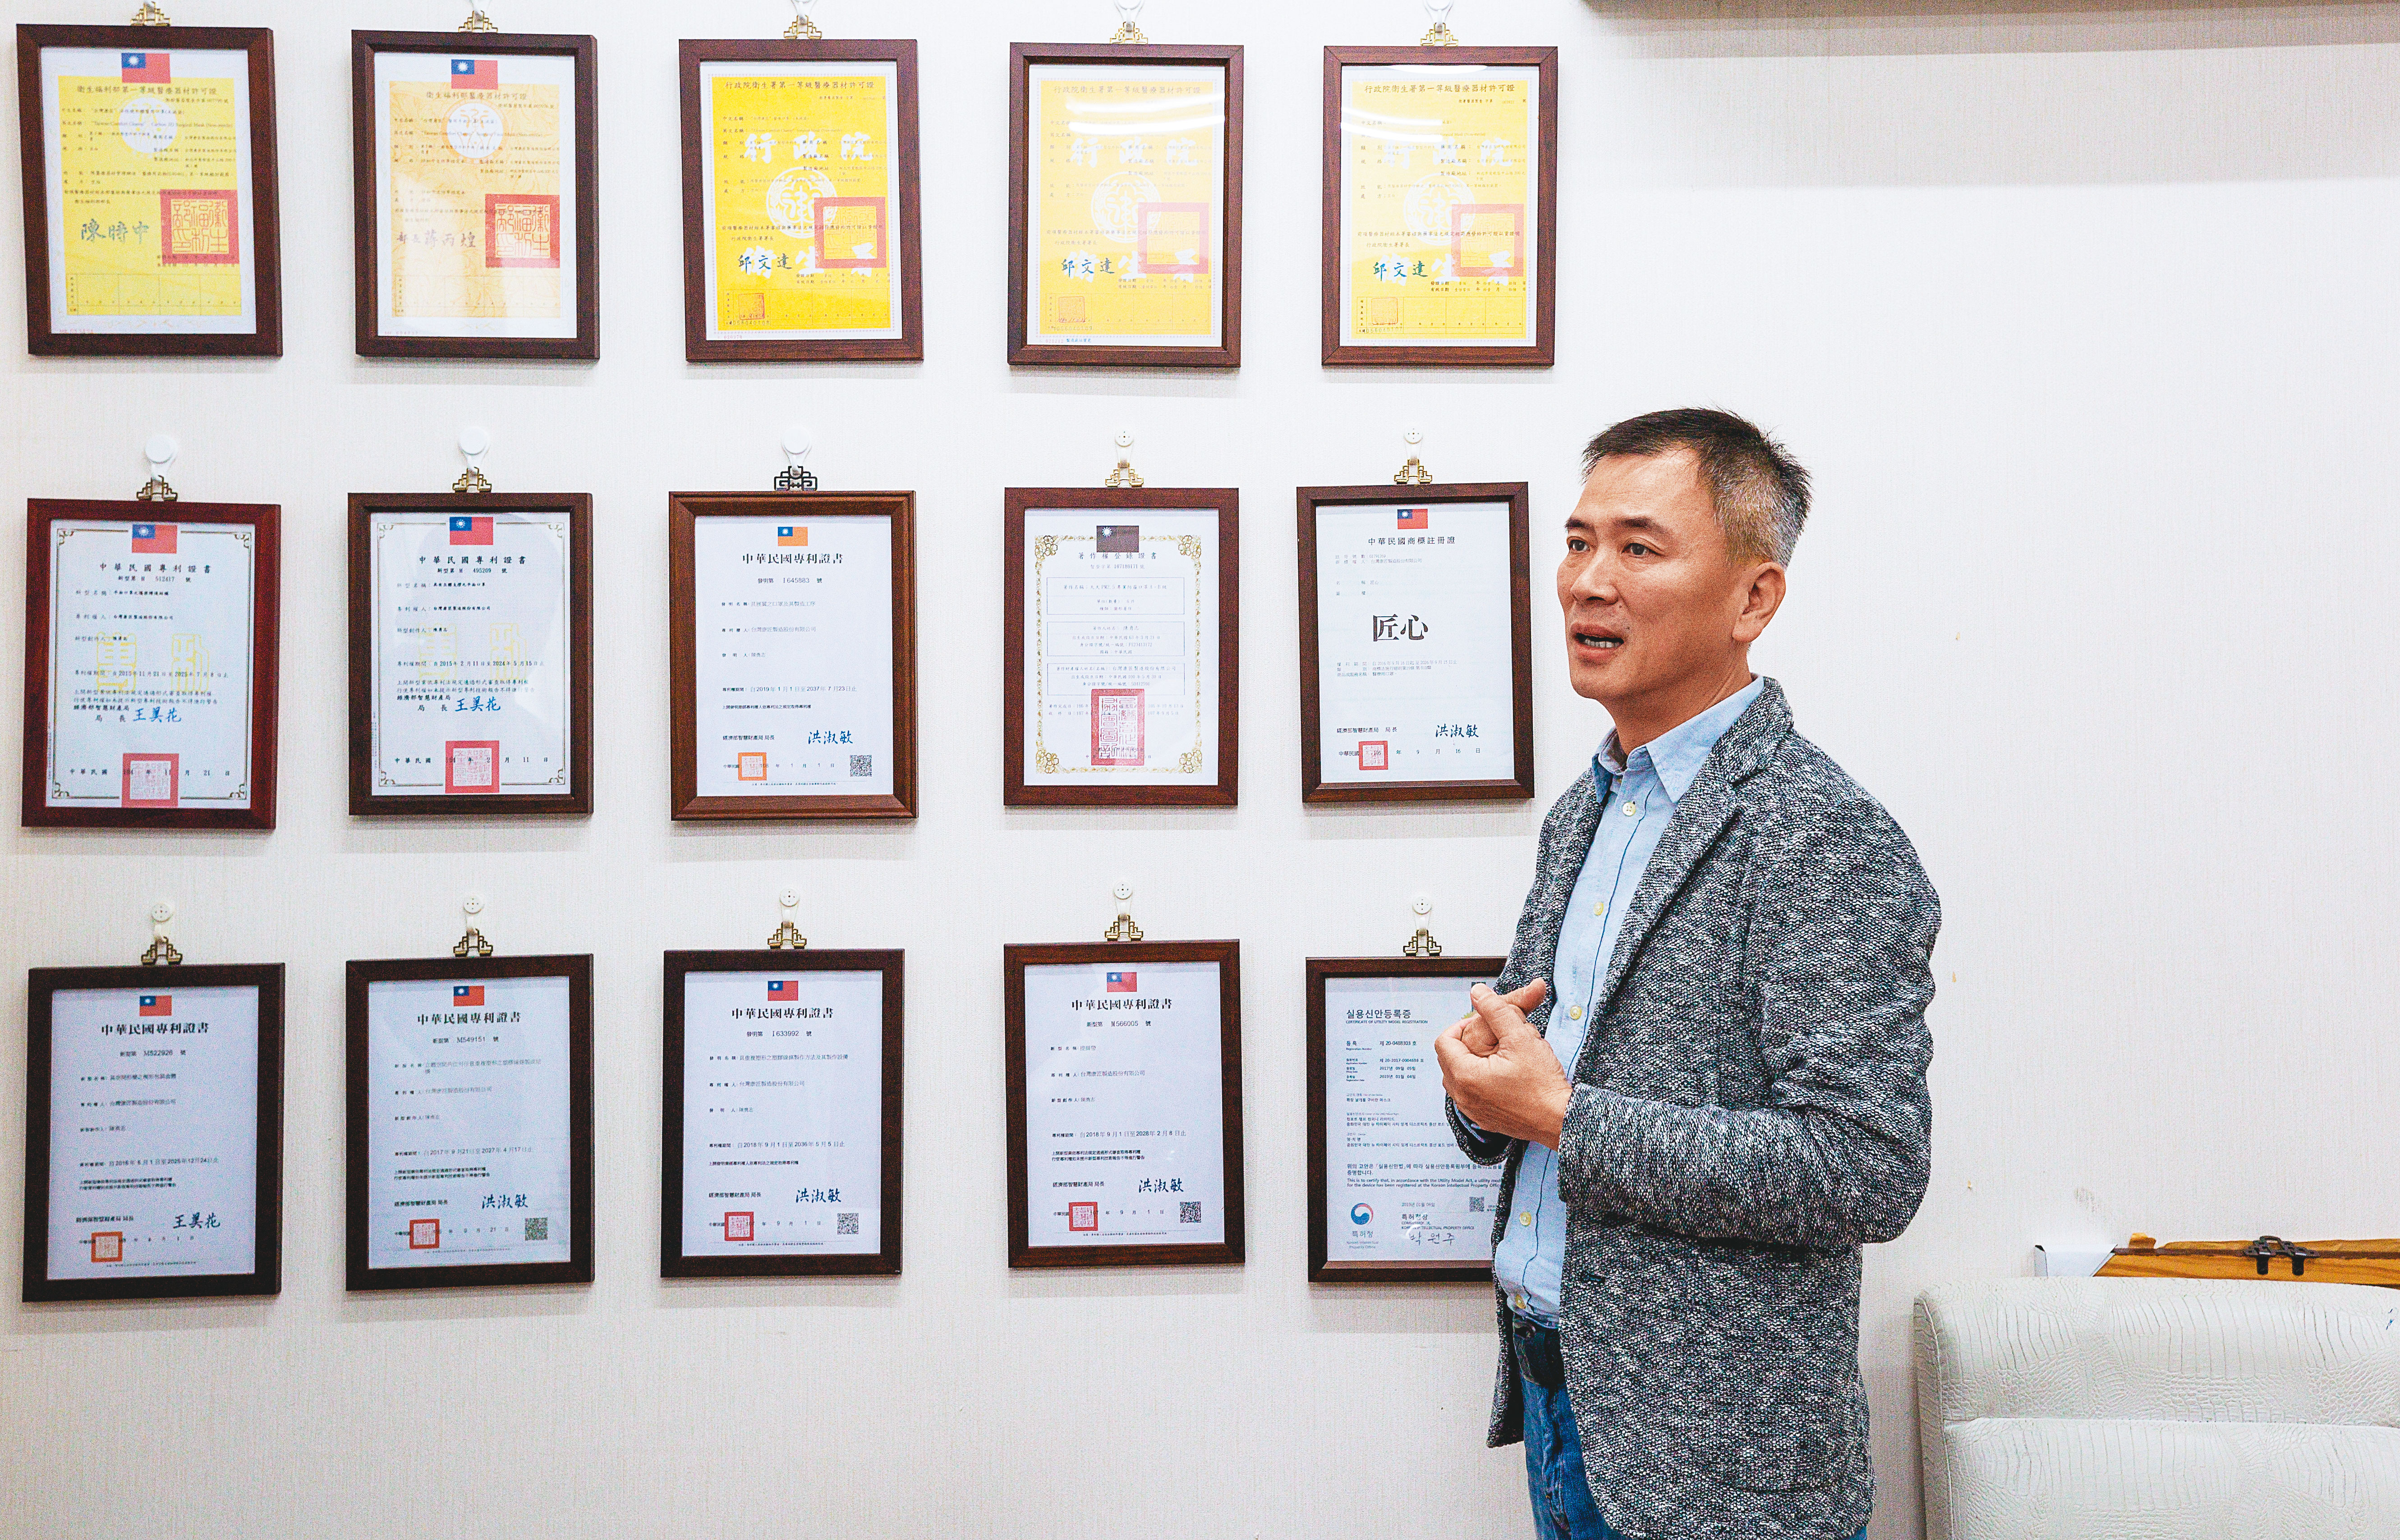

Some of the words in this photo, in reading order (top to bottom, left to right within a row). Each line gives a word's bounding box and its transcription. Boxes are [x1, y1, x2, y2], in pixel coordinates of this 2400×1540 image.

[1364, 84, 1515, 94] 行政院衛生署第一等級醫療器材許可證
[738, 253, 792, 274] 邱文達
[1062, 257, 1115, 278] 邱文達
[1373, 260, 1428, 281] 邱文達
[1368, 536, 1456, 545] 中華民國商標註冊證
[419, 555, 527, 565] 中華民國專利證書
[742, 553, 843, 564] 中華民國專利證書
[1373, 614, 1428, 642] 匠心
[455, 696, 501, 712] 王美花
[133, 706, 182, 723] 王美花
[808, 730, 853, 745] 洪淑敏
[1435, 724, 1479, 738] 洪淑敏
[1071, 999, 1172, 1011] 中華民國專利證書
[417, 1012, 521, 1026] 中華民國專利證書
[731, 1008, 834, 1019] 中華民國專利證書
[1346, 1009, 1411, 1019] 실용신안등록증
[101, 1022, 209, 1036] 中華民國專利證書
[1138, 1178, 1184, 1193] 洪淑敏
[482, 1193, 528, 1209] 洪淑敏
[795, 1187, 841, 1203] 洪淑敏
[173, 1212, 221, 1229] 王美花
